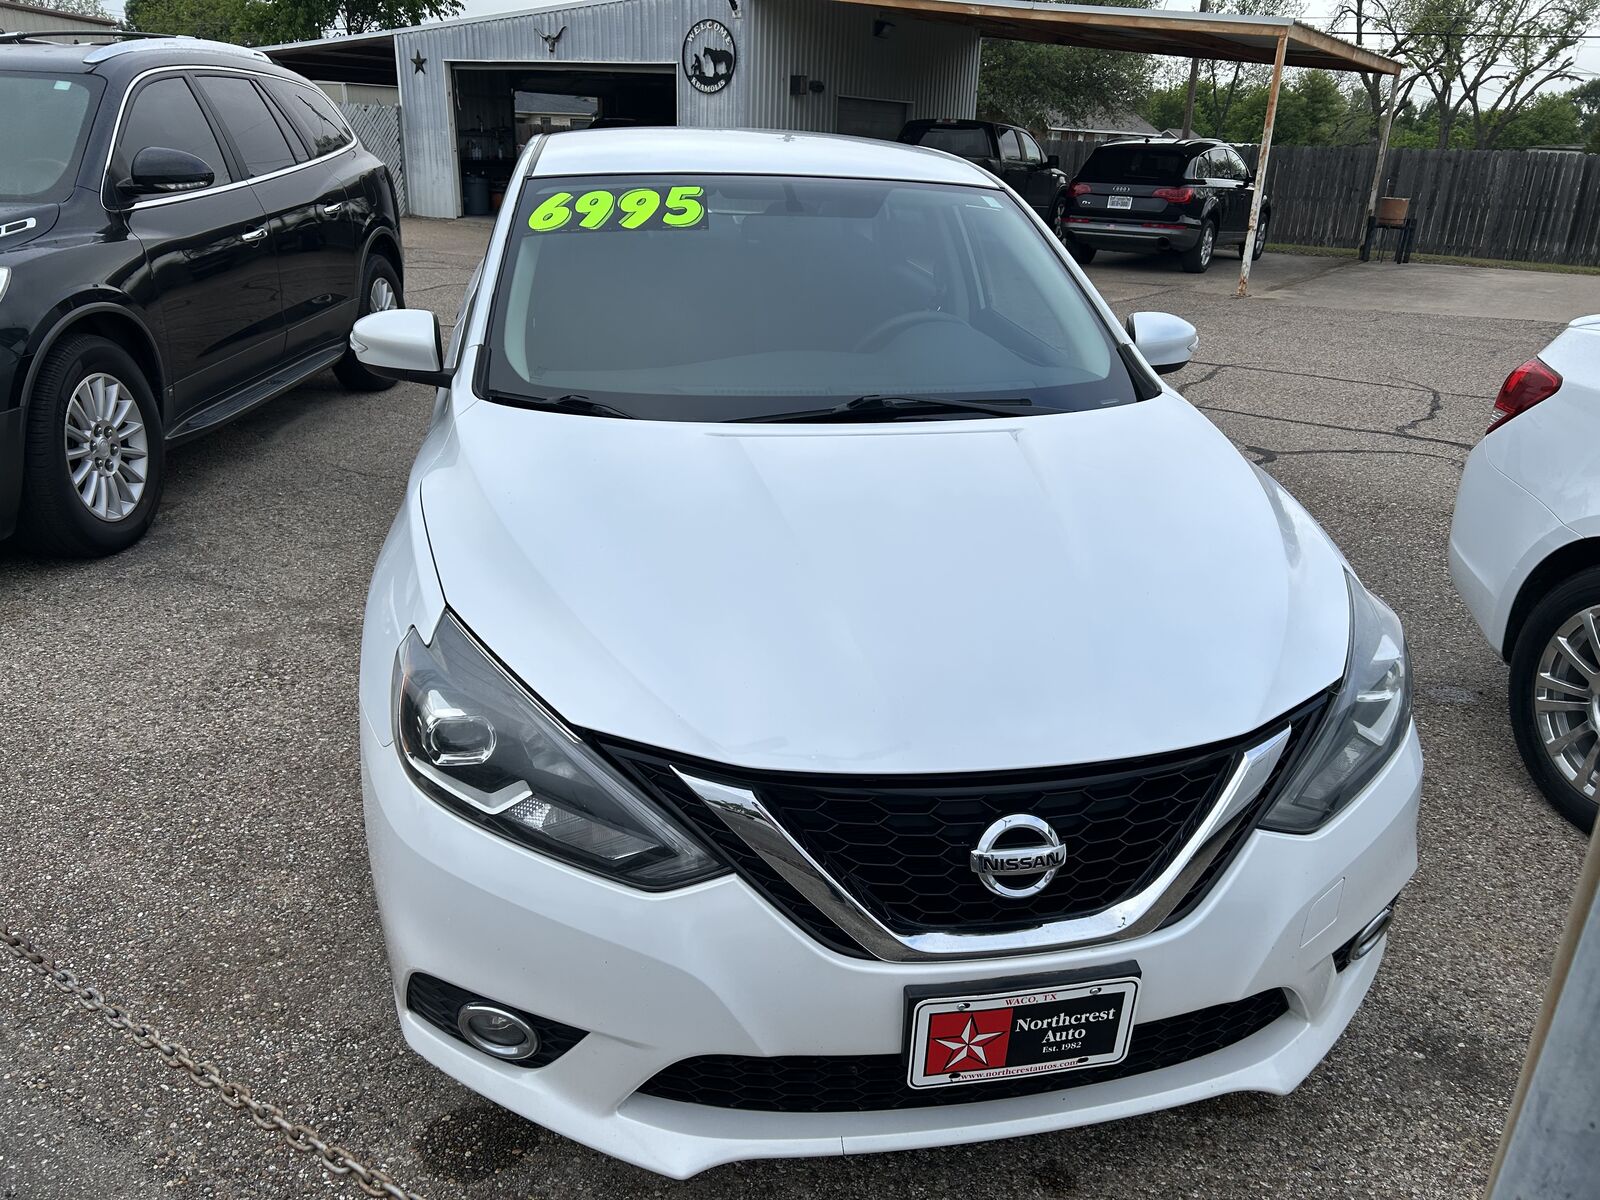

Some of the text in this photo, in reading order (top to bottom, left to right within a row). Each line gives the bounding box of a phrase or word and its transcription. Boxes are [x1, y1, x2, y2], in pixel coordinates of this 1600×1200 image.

[686, 21, 733, 46] WELCOME
[691, 77, 725, 92] KRAMOLIS
[528, 186, 705, 232] 6995
[982, 851, 1059, 872] NISSAN
[1043, 993, 1057, 1001] TX
[1015, 1008, 1116, 1032] Northcrest
[1041, 1028, 1086, 1044] Auto
[1061, 1041, 1082, 1051] 1982
